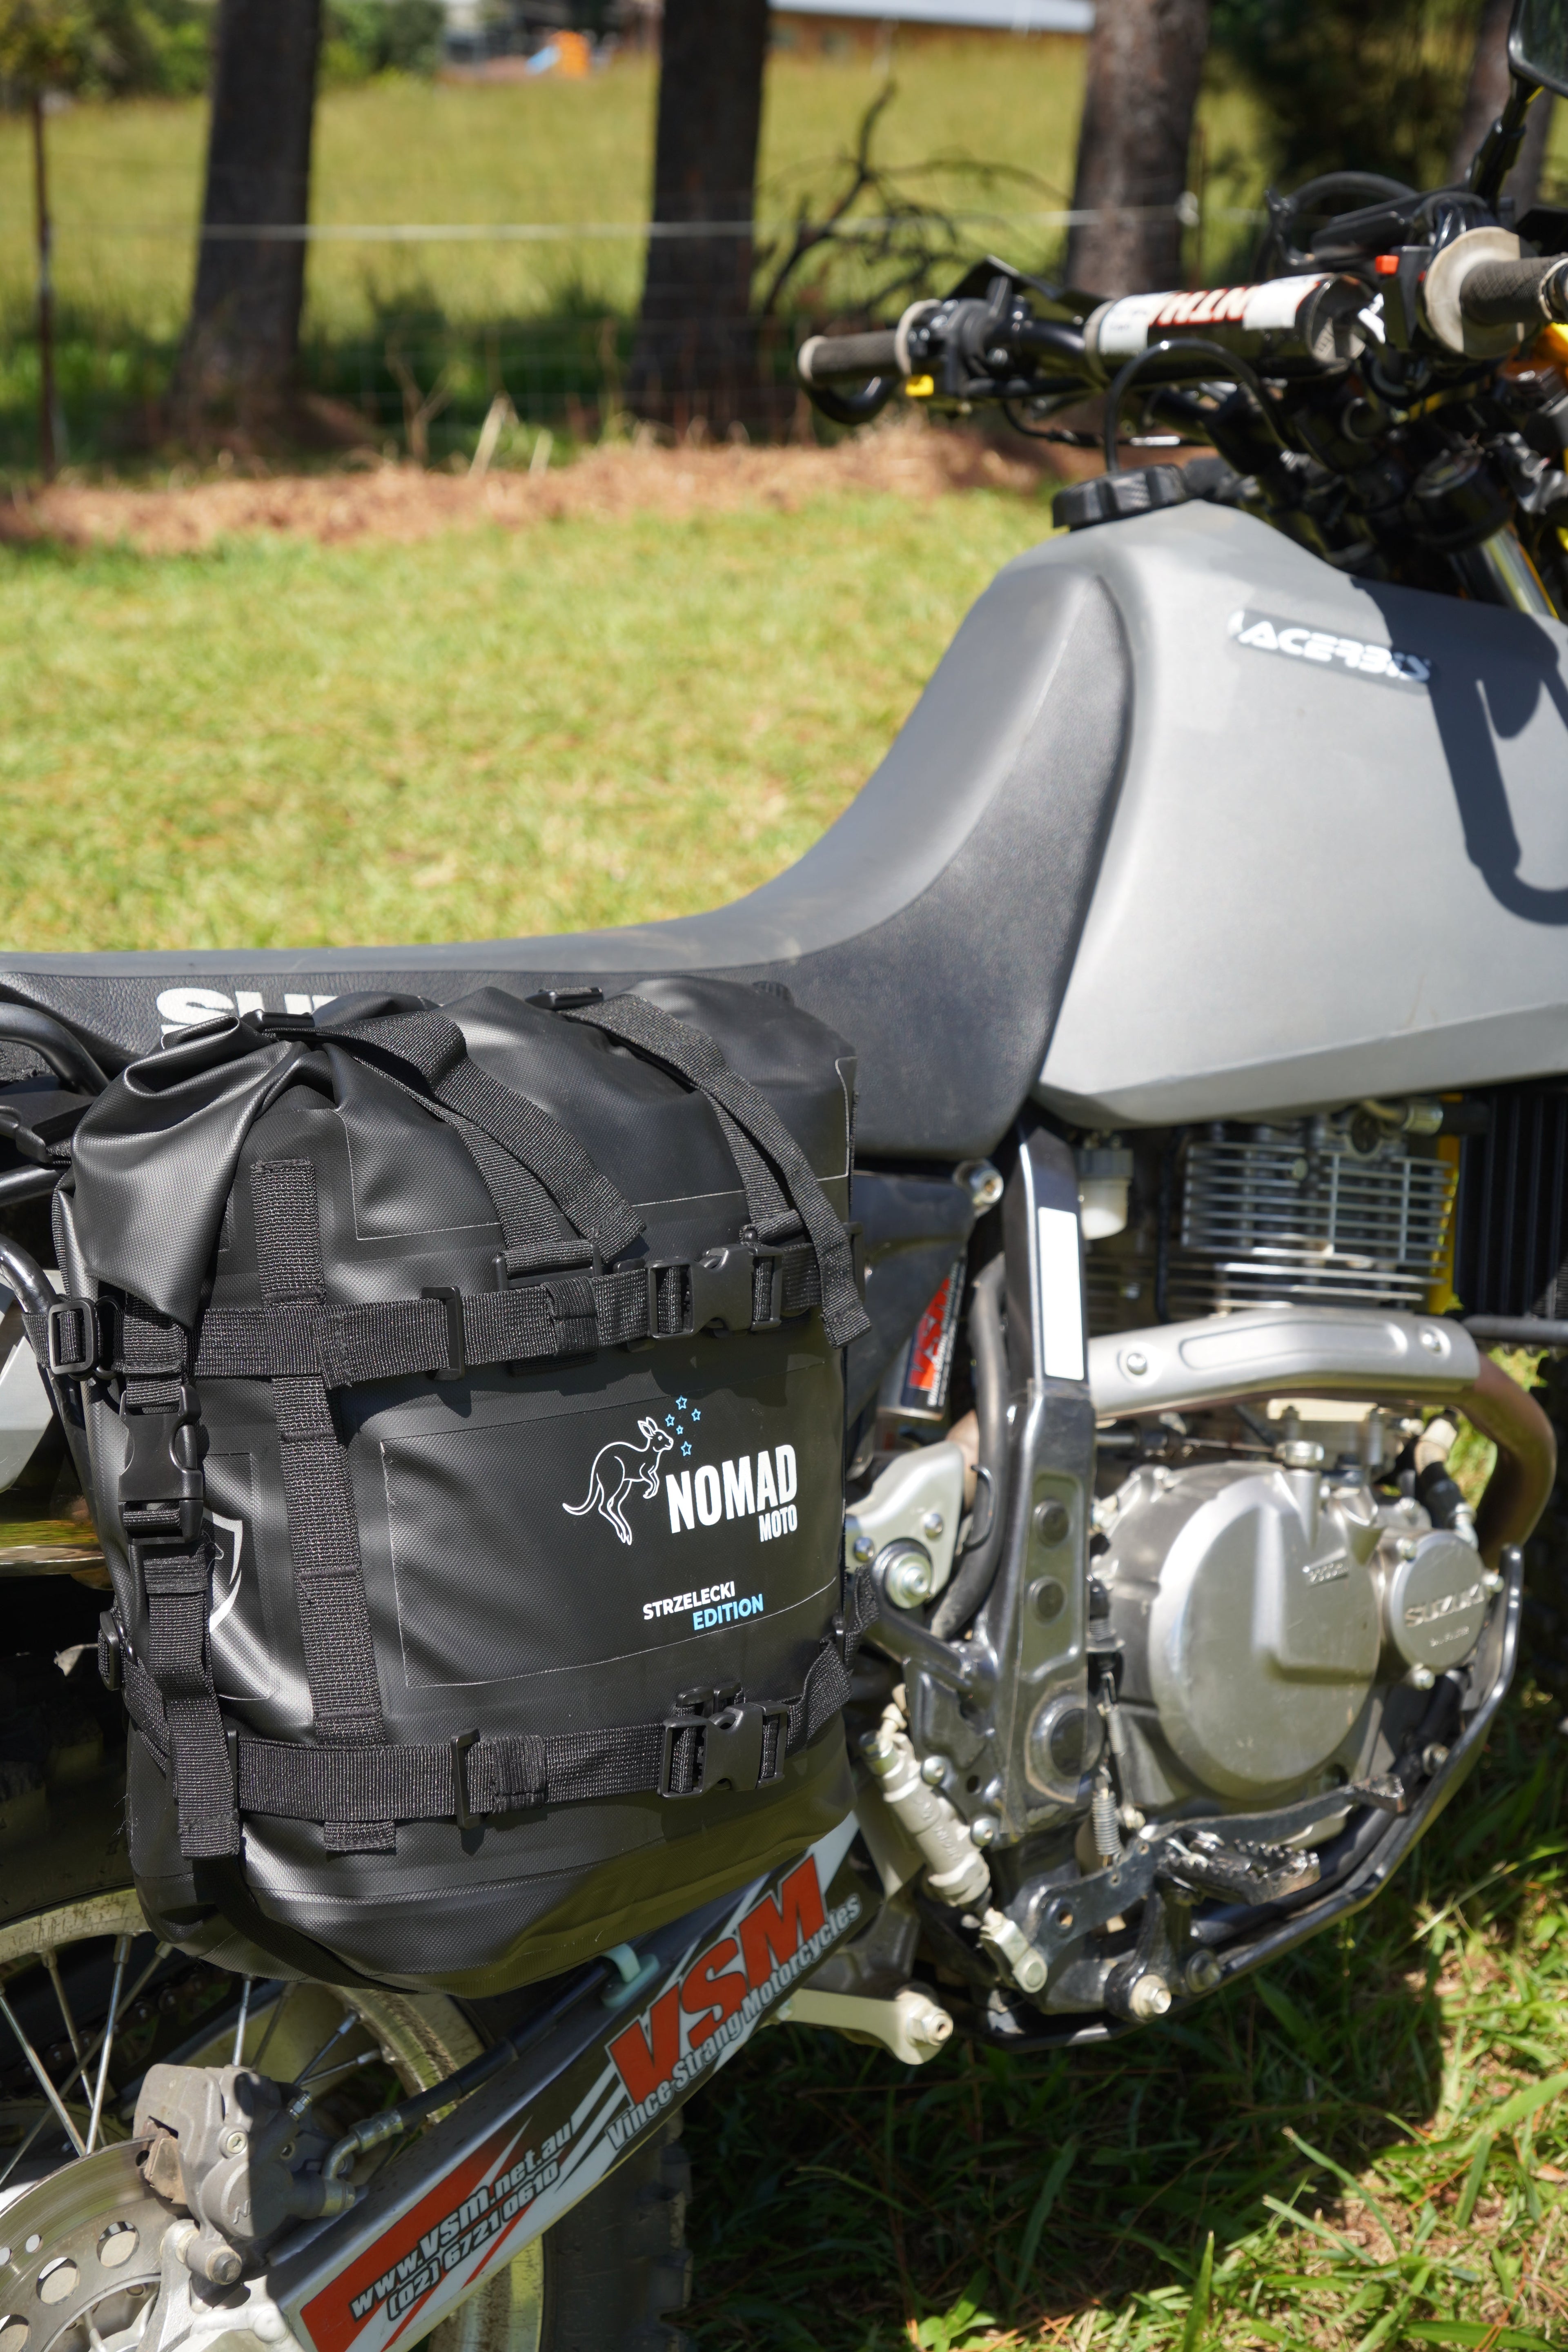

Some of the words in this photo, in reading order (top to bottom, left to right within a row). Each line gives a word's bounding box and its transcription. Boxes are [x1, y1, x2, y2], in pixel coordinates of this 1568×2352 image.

[666, 1444, 797, 1533] NOMAD
[758, 1504, 797, 1542] MOTO
[643, 1581, 735, 1619] STRZELECKI
[693, 1594, 764, 1630] EDITION
[606, 2080, 672, 2149] Vince
[672, 2011, 745, 2090] Strang
[741, 1895, 860, 2022] Motorcycles
[609, 1853, 827, 2105] VSM
[388, 2259, 441, 2320] (02)
[443, 2208, 501, 2271] 6721
[503, 2161, 559, 2221] 0610
